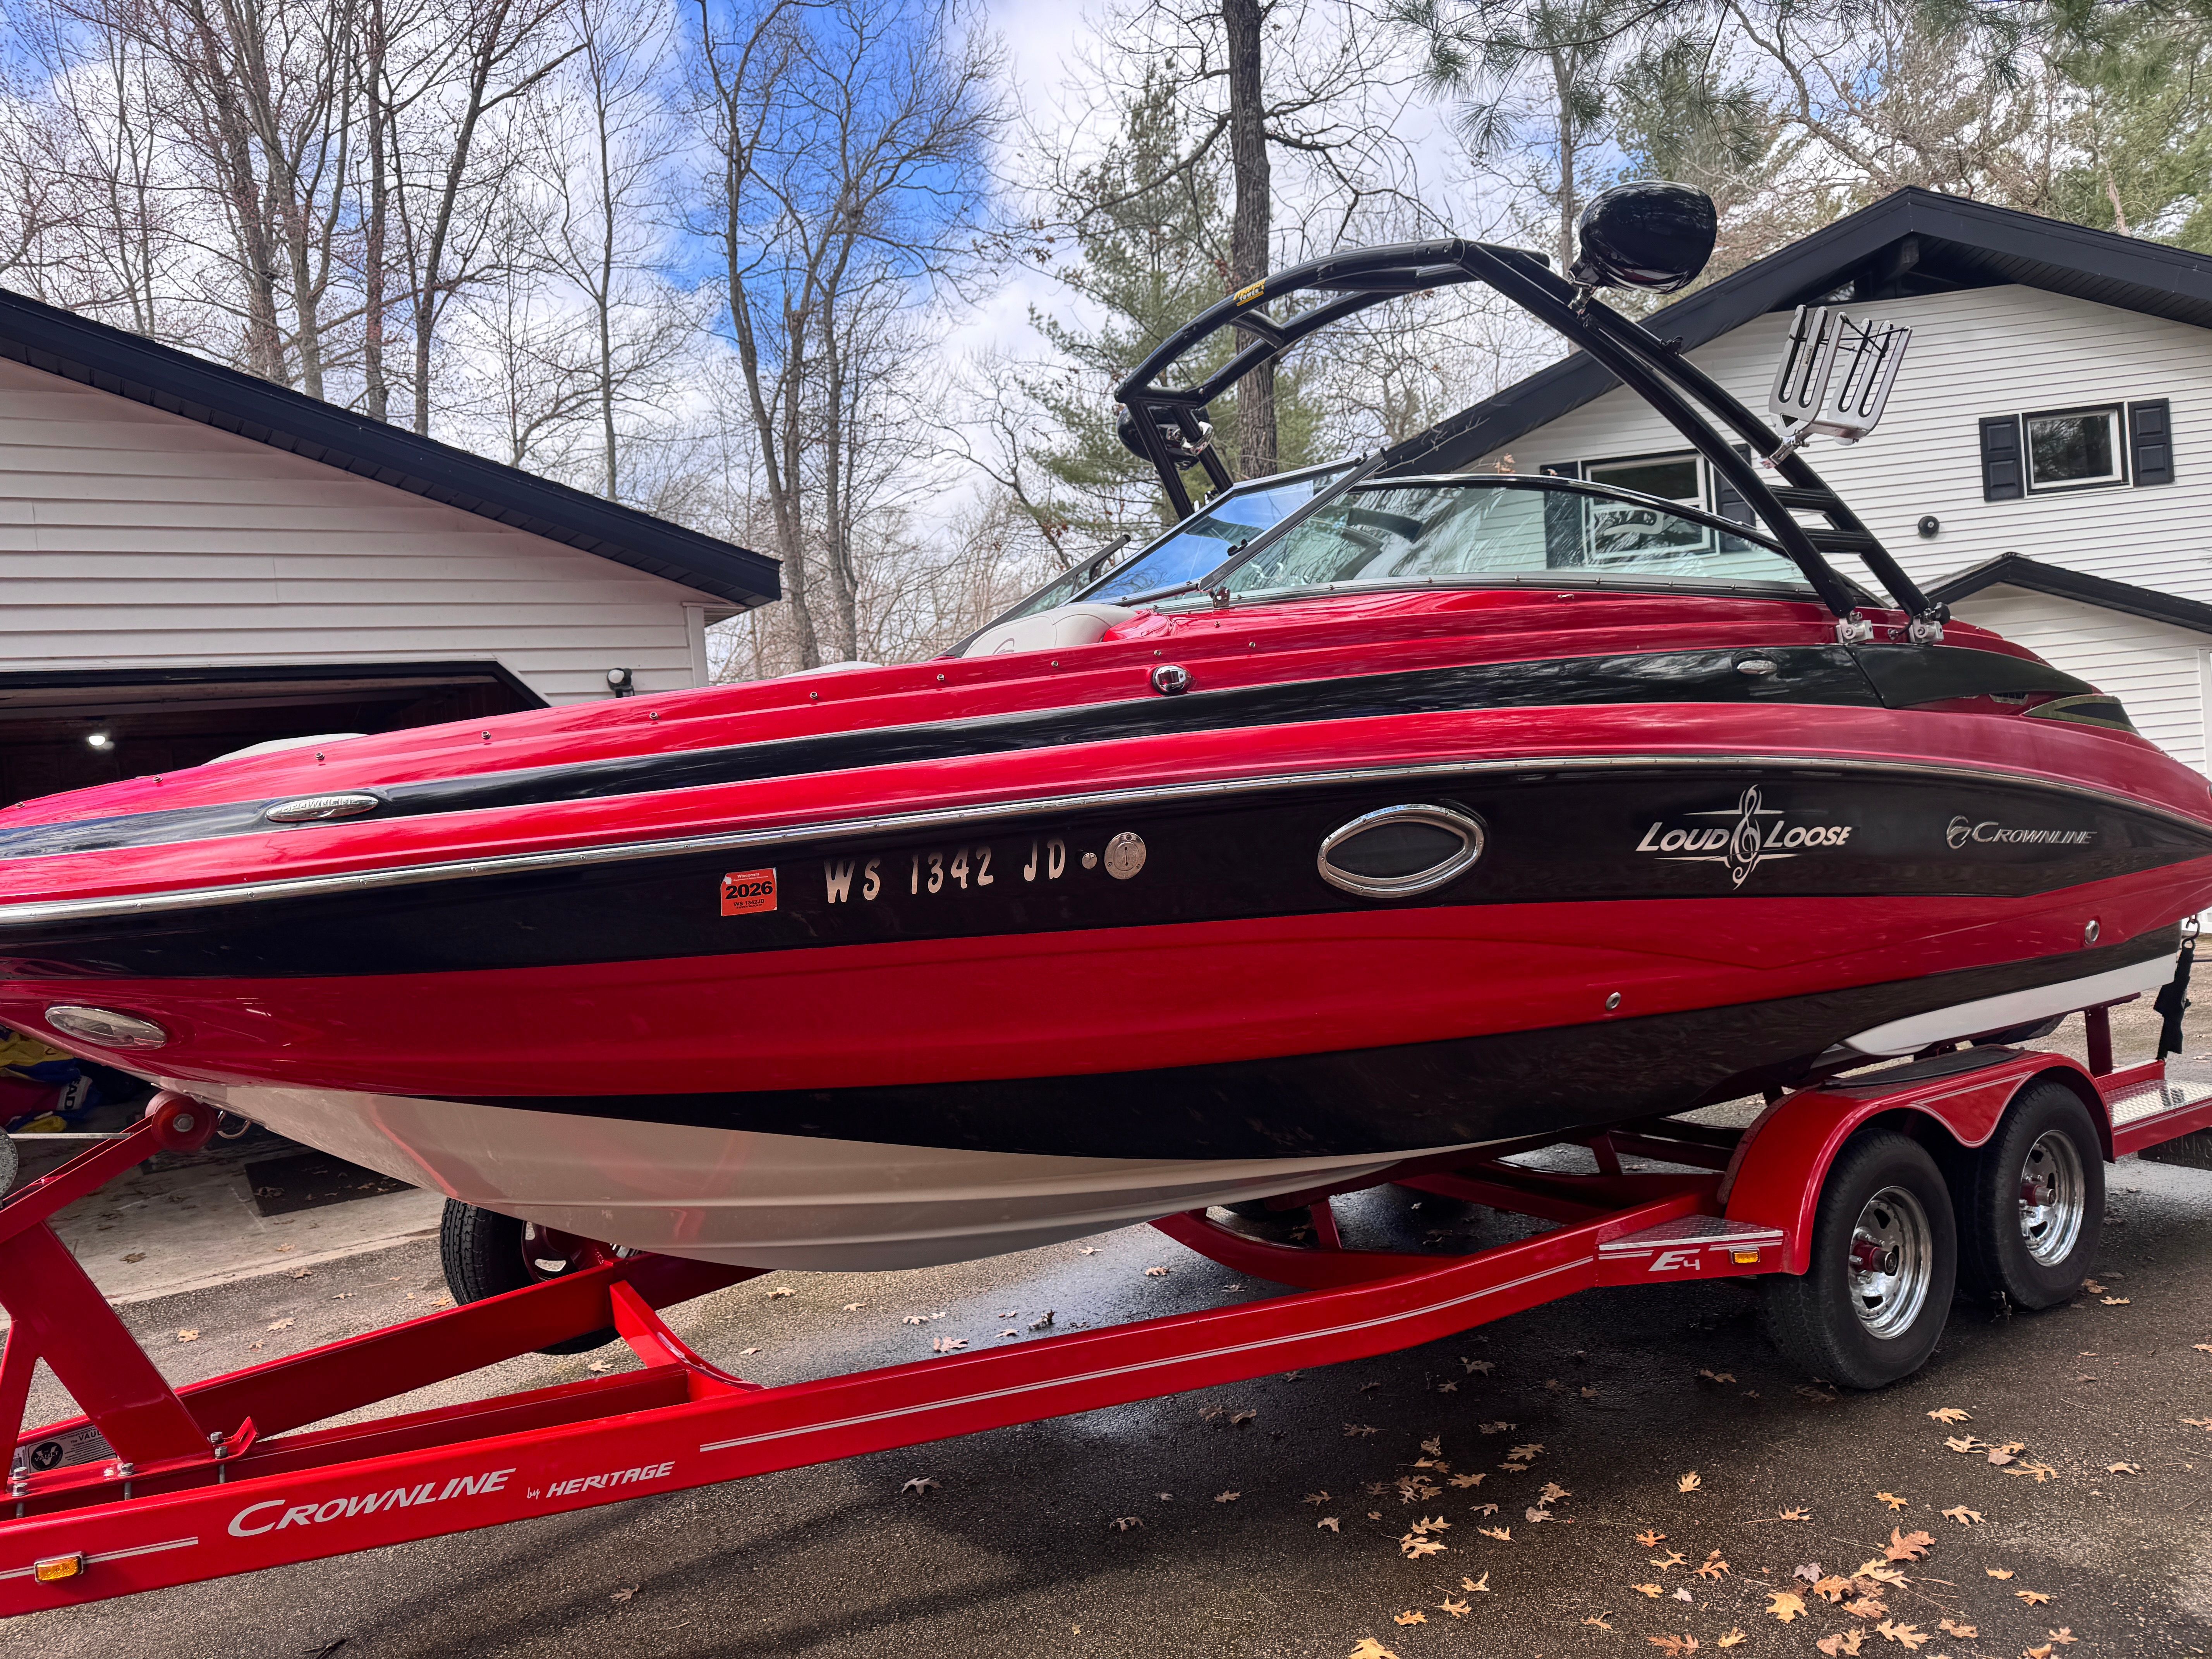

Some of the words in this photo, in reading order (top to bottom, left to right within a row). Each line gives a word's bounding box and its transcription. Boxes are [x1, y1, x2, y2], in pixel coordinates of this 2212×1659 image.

[1972, 821, 2097, 843] CROWNLINE
[824, 858, 880, 903] WS
[911, 846, 993, 895] 1342
[1024, 838, 1066, 881] JD
[725, 881, 773, 899] 2026
[1648, 1249, 1701, 1272] E4
[78, 1430, 102, 1441] VAUL
[34, 1450, 59, 1461] VAULT
[227, 1468, 517, 1537] CROWNLINE
[527, 1487, 540, 1500] by
[546, 1461, 675, 1498] HERITAGE
